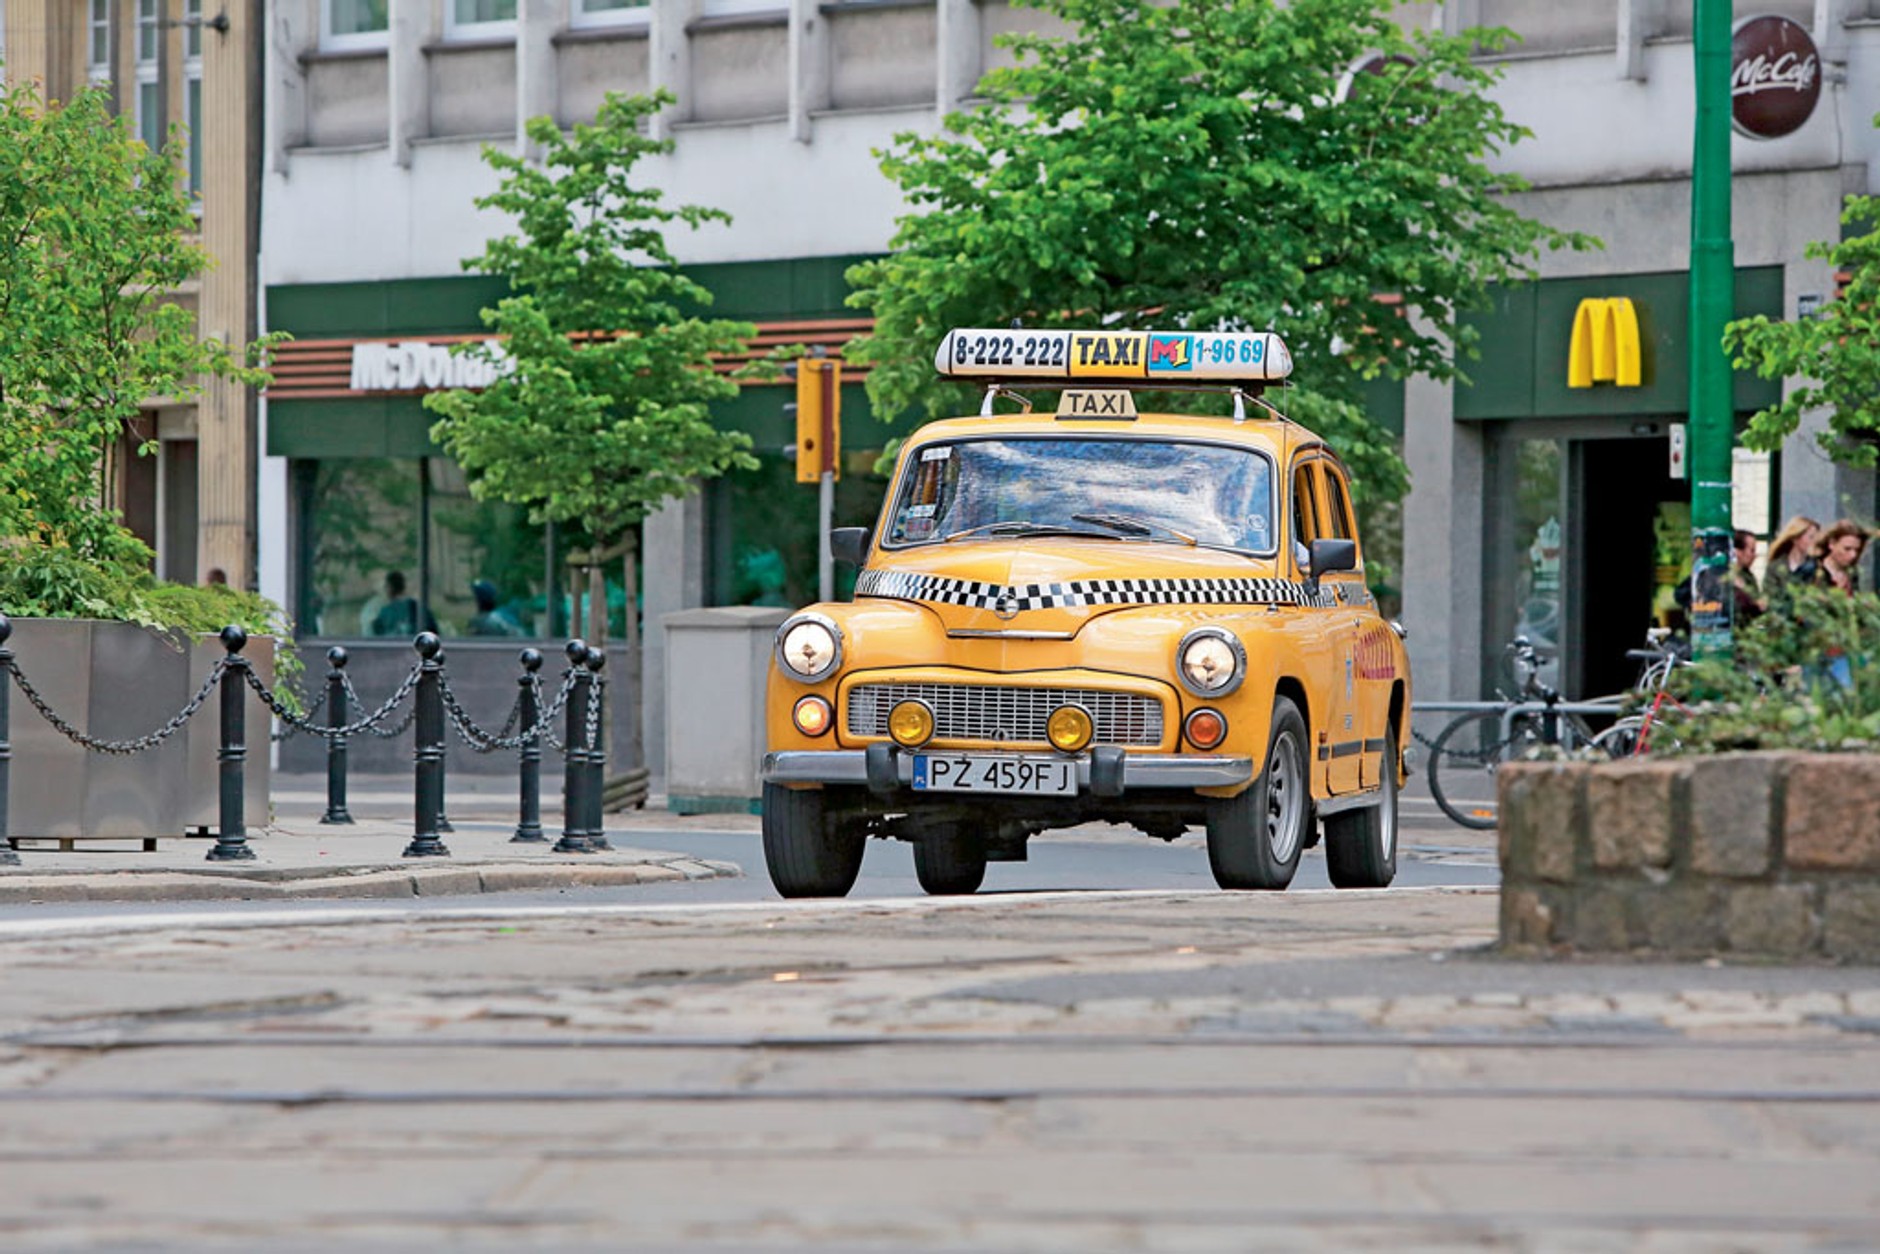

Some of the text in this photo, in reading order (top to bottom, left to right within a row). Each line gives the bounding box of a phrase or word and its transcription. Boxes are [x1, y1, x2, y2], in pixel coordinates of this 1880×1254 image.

[955, 336, 1064, 366] 8-222-222
[1077, 337, 1141, 366] TAXI
[1067, 393, 1126, 414] TAXI
[931, 759, 972, 788] PZ
